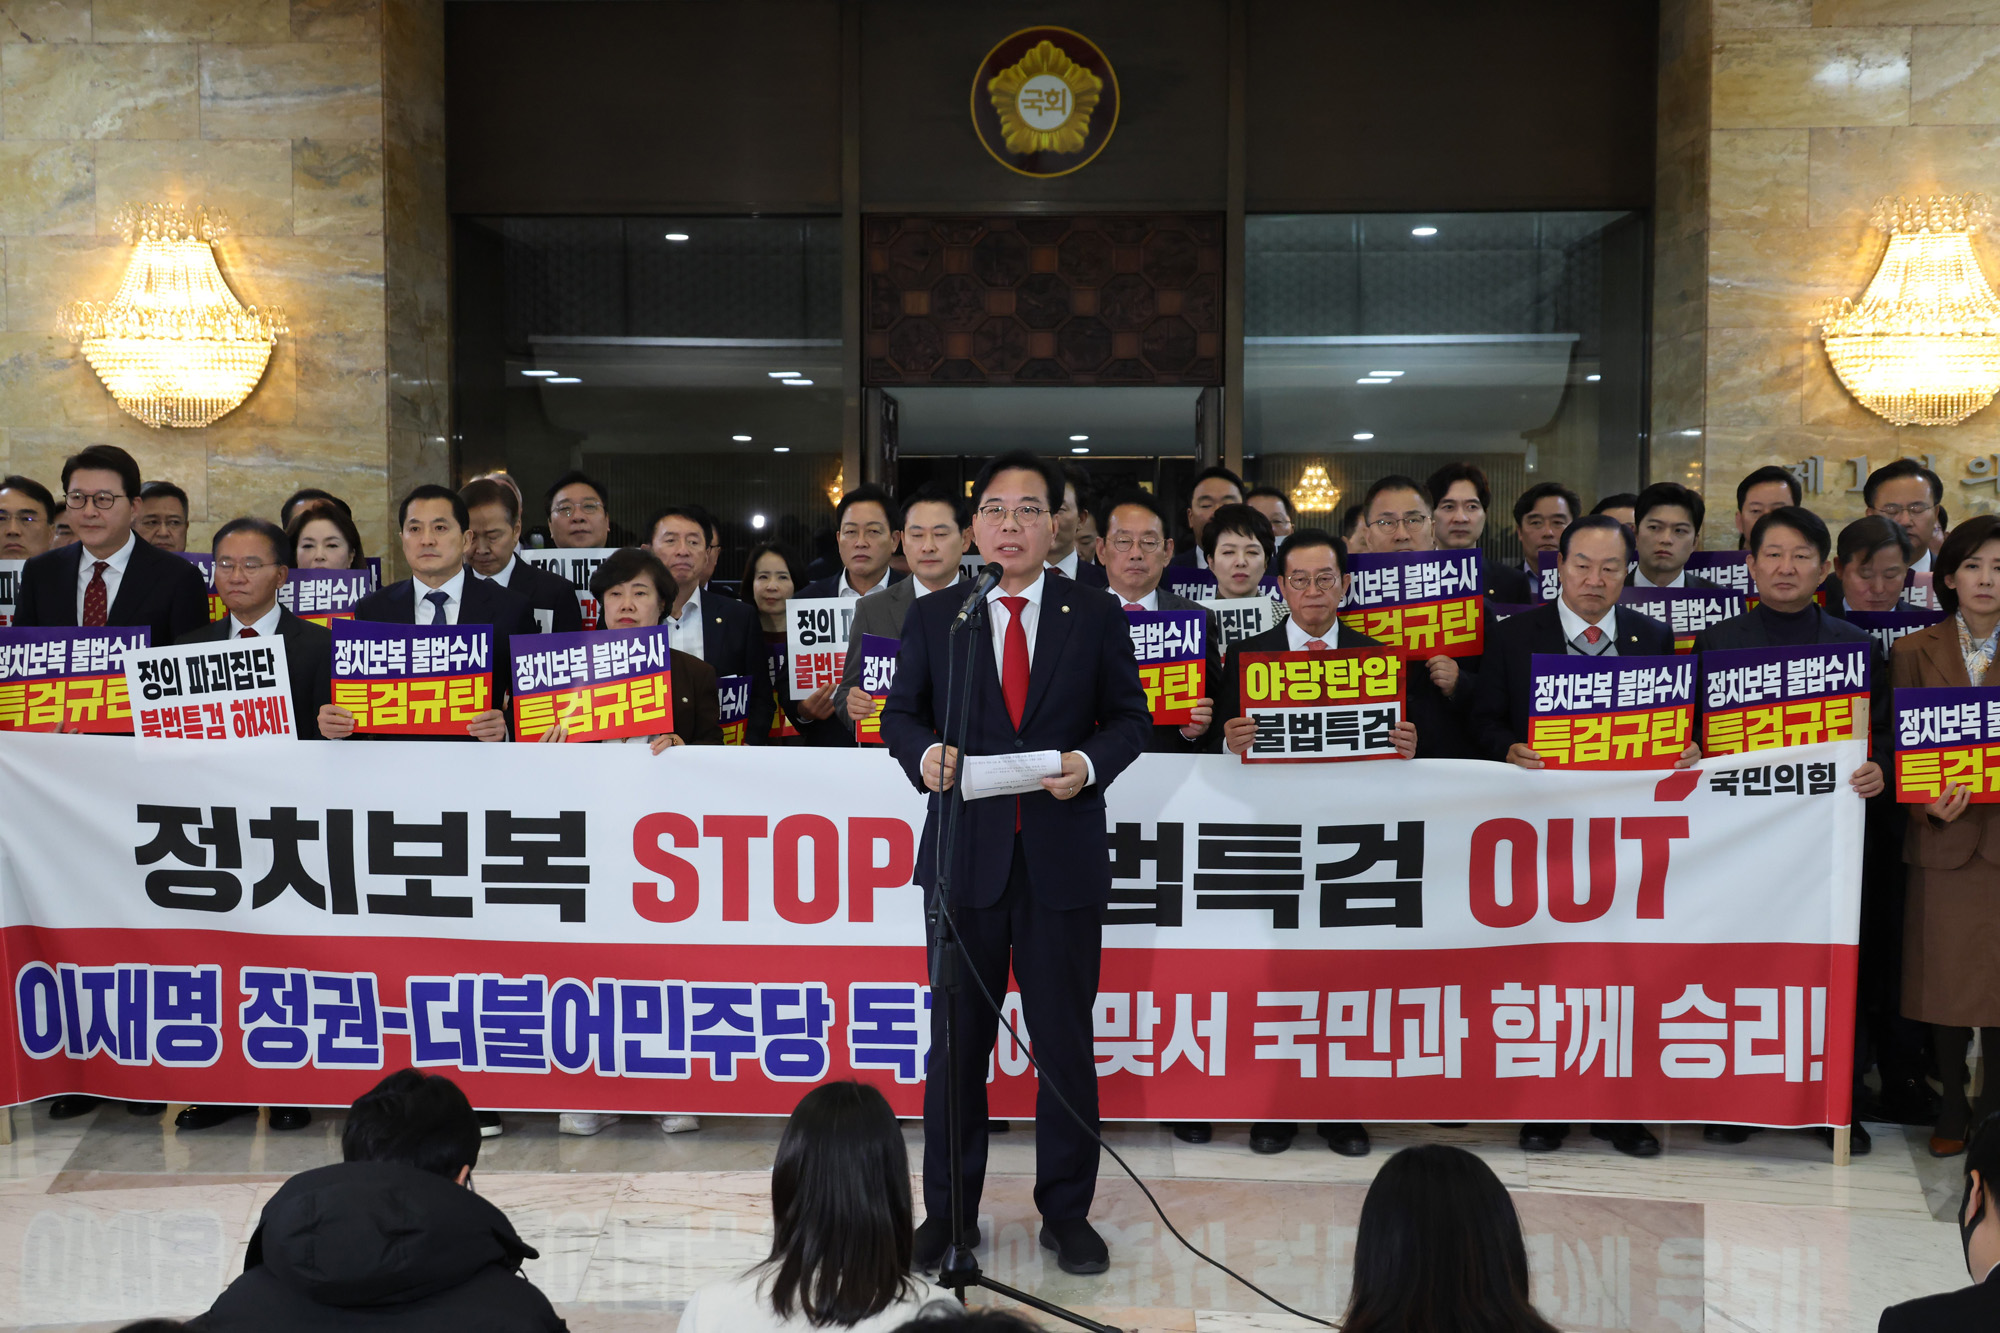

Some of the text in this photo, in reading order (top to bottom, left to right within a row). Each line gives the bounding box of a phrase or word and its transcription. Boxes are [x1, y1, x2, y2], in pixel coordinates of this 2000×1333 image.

[1021, 88, 1067, 117] 국회
[299, 576, 366, 611] 불법수사
[1340, 556, 1478, 606] 치보복 불법수사
[797, 608, 835, 646] 정의
[1671, 597, 1740, 632] 불법수사
[335, 632, 488, 676] 정치보복 불법수사
[516, 633, 665, 692] 정치보복 불법수사
[1129, 619, 1201, 661] 불법수사
[138, 648, 276, 701] 정의 파괴집단
[1246, 655, 1401, 701] 야당탄압
[1535, 663, 1692, 712] 정치보복 불법수사
[1707, 651, 1865, 708] 정치보복 불법수사
[230, 695, 290, 739] 해체!
[335, 677, 488, 727] 특검규탄
[519, 675, 668, 736] 특검규탄
[1900, 702, 1981, 746] 정치보복
[1251, 707, 1396, 753] 불법특검
[1532, 708, 1690, 764] 특검규탄
[1709, 762, 1837, 796] 국민의힘
[135, 804, 590, 924] 정치보복
[632, 812, 914, 925] STOP
[1469, 816, 1690, 929] OUT
[15, 961, 224, 1067] 이재명
[239, 965, 835, 1083] 정권-더불어민주당
[1092, 991, 1228, 1077] 맞서
[1253, 984, 1469, 1079] 국민과
[1491, 982, 1634, 1079] 함께
[1659, 984, 1826, 1083] 승리!
